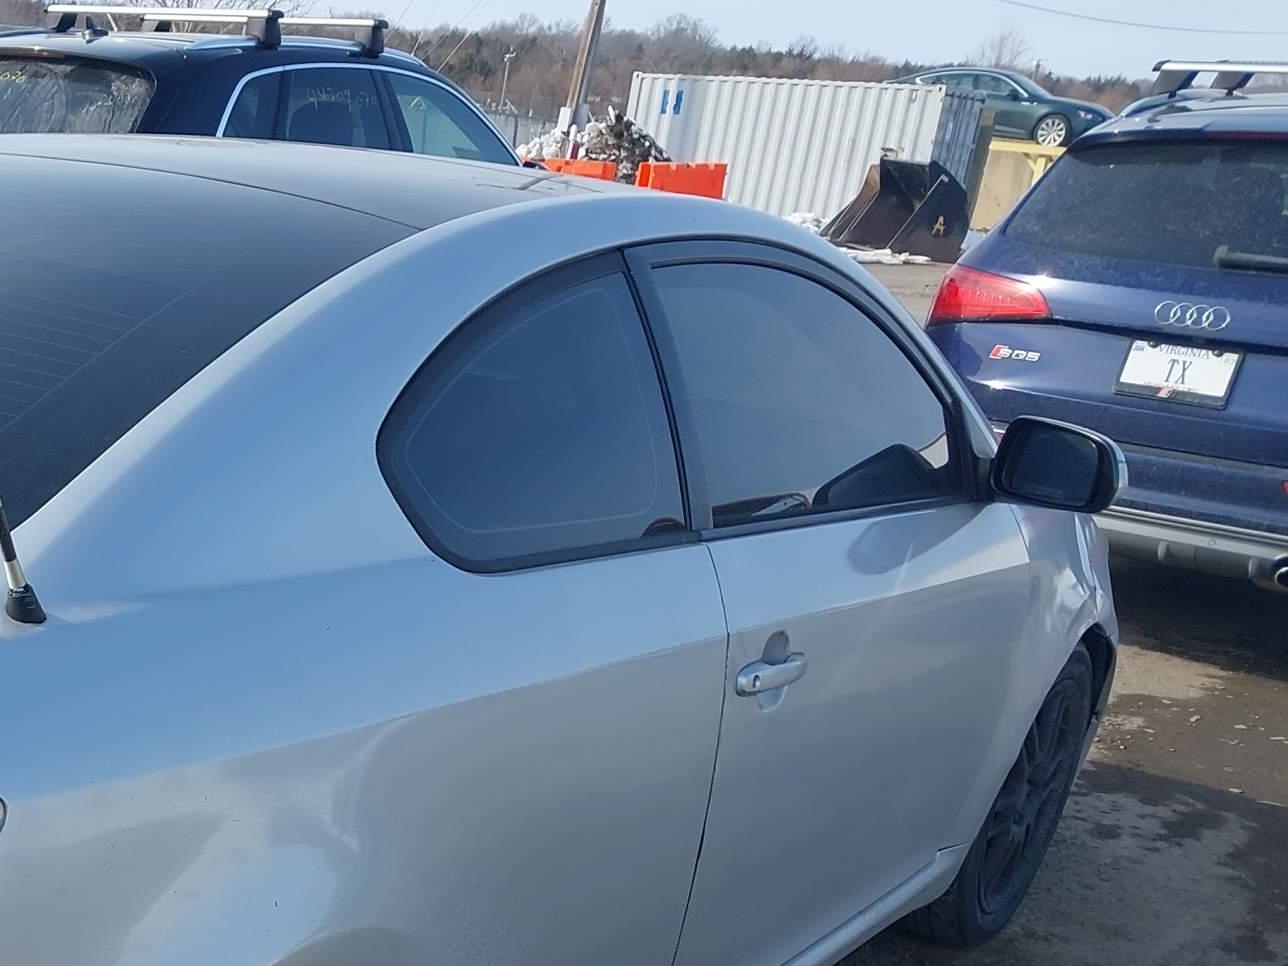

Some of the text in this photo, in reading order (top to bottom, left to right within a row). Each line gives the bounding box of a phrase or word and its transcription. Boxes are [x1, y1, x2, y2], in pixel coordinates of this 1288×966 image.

[996, 345, 1041, 362] SQ5
[1158, 343, 1212, 360] VIRGINIA
[1164, 358, 1192, 385] TX
